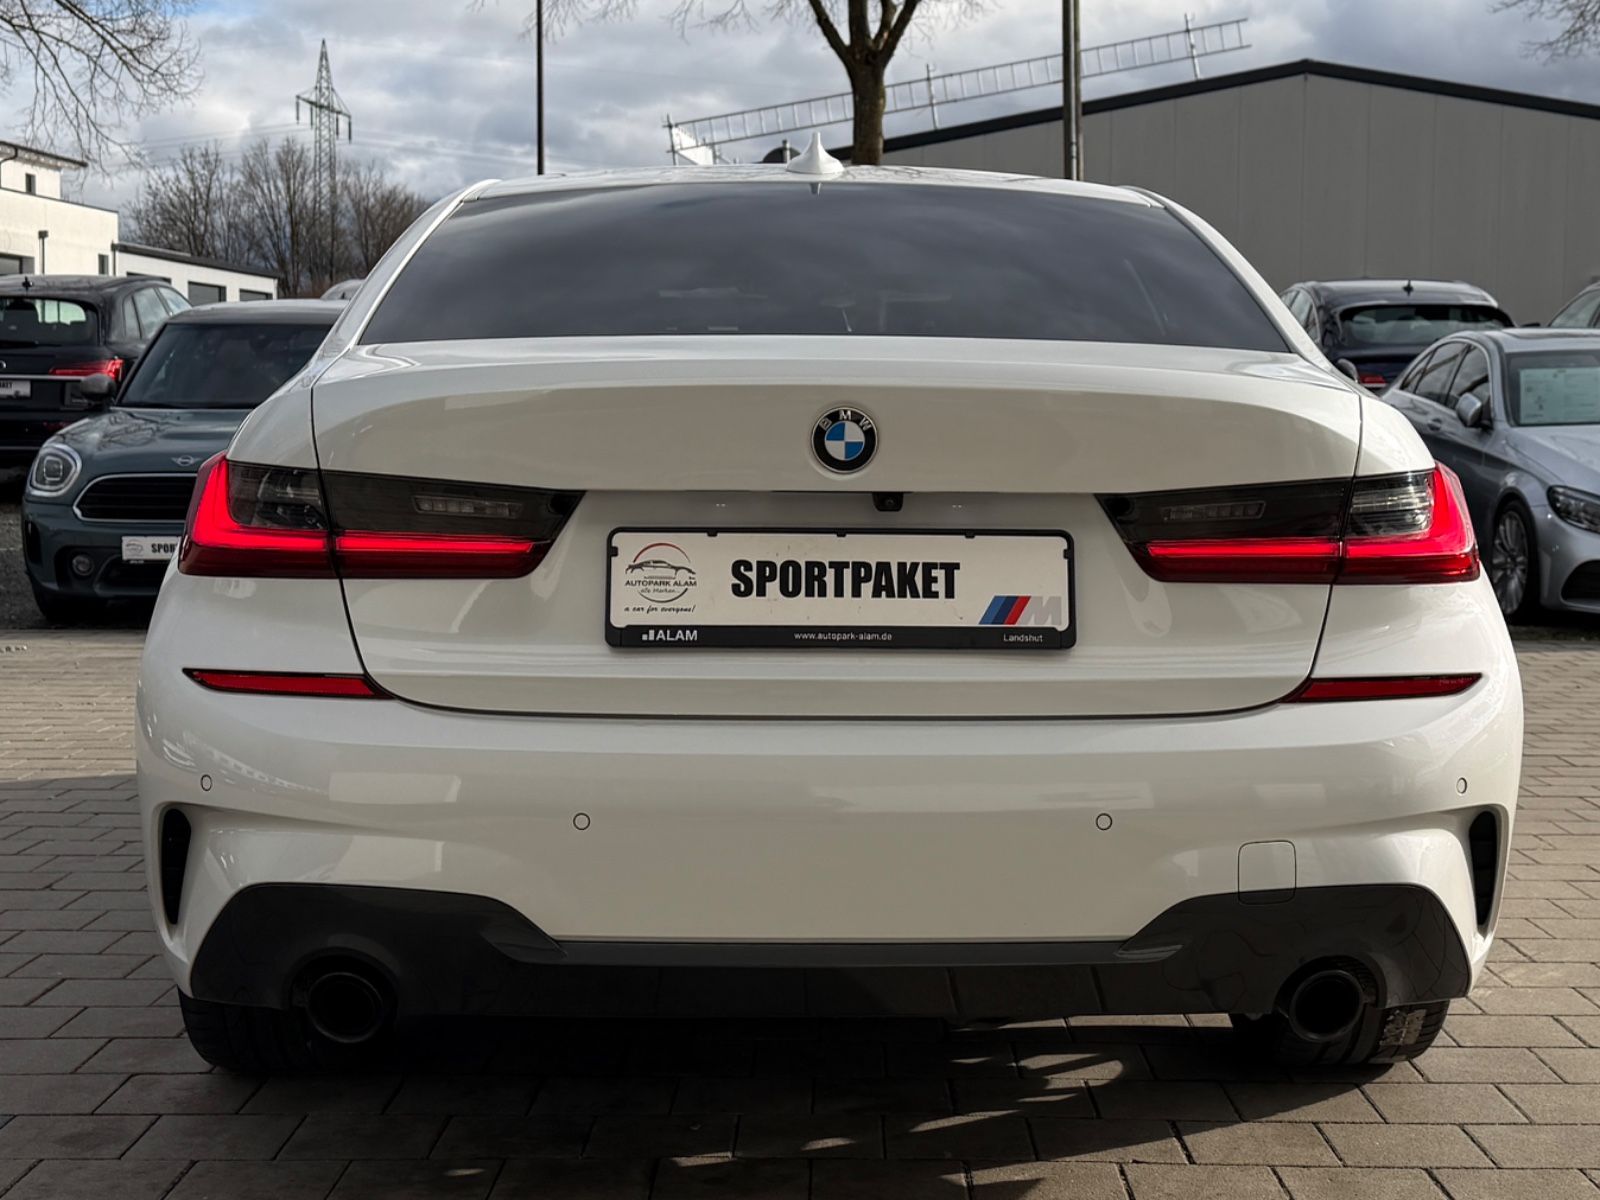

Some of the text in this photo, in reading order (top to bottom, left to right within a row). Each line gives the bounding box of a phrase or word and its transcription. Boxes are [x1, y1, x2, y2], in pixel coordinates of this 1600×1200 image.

[819, 409, 872, 431] BMW
[731, 559, 961, 599] SPORTPAKET
[646, 604, 658, 614] for
[661, 604, 696, 613] everyone!
[655, 629, 698, 641] ALAM
[793, 631, 893, 642] www.autopark-alam.de
[1003, 633, 1043, 643] Landshut
